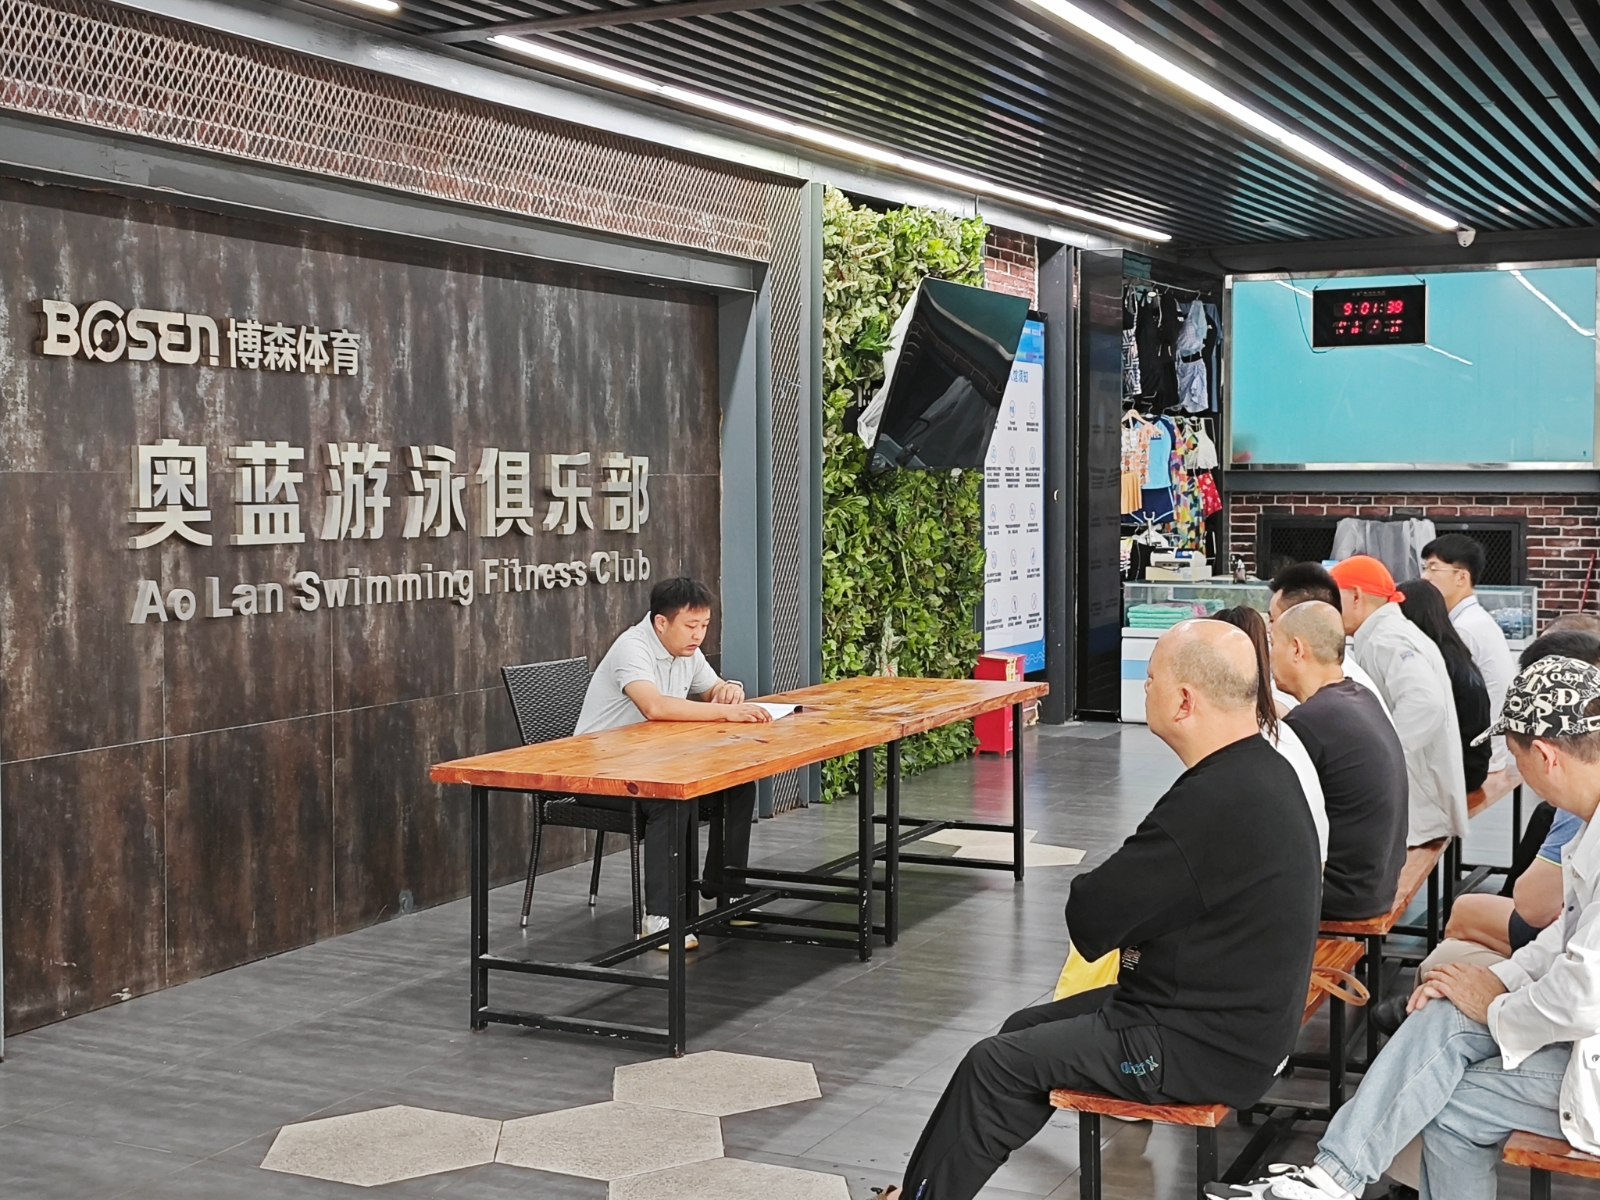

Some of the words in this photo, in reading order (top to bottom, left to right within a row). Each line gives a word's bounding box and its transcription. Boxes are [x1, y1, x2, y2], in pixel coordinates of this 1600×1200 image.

[226, 317, 361, 376] 博森体育
[128, 438, 650, 549] 奥蓝游泳俱乐部
[130, 579, 197, 624] Ao
[205, 576, 284, 618] Lan
[293, 563, 473, 611] Swimming
[480, 558, 588, 594] Fitness
[590, 549, 650, 584] Club
